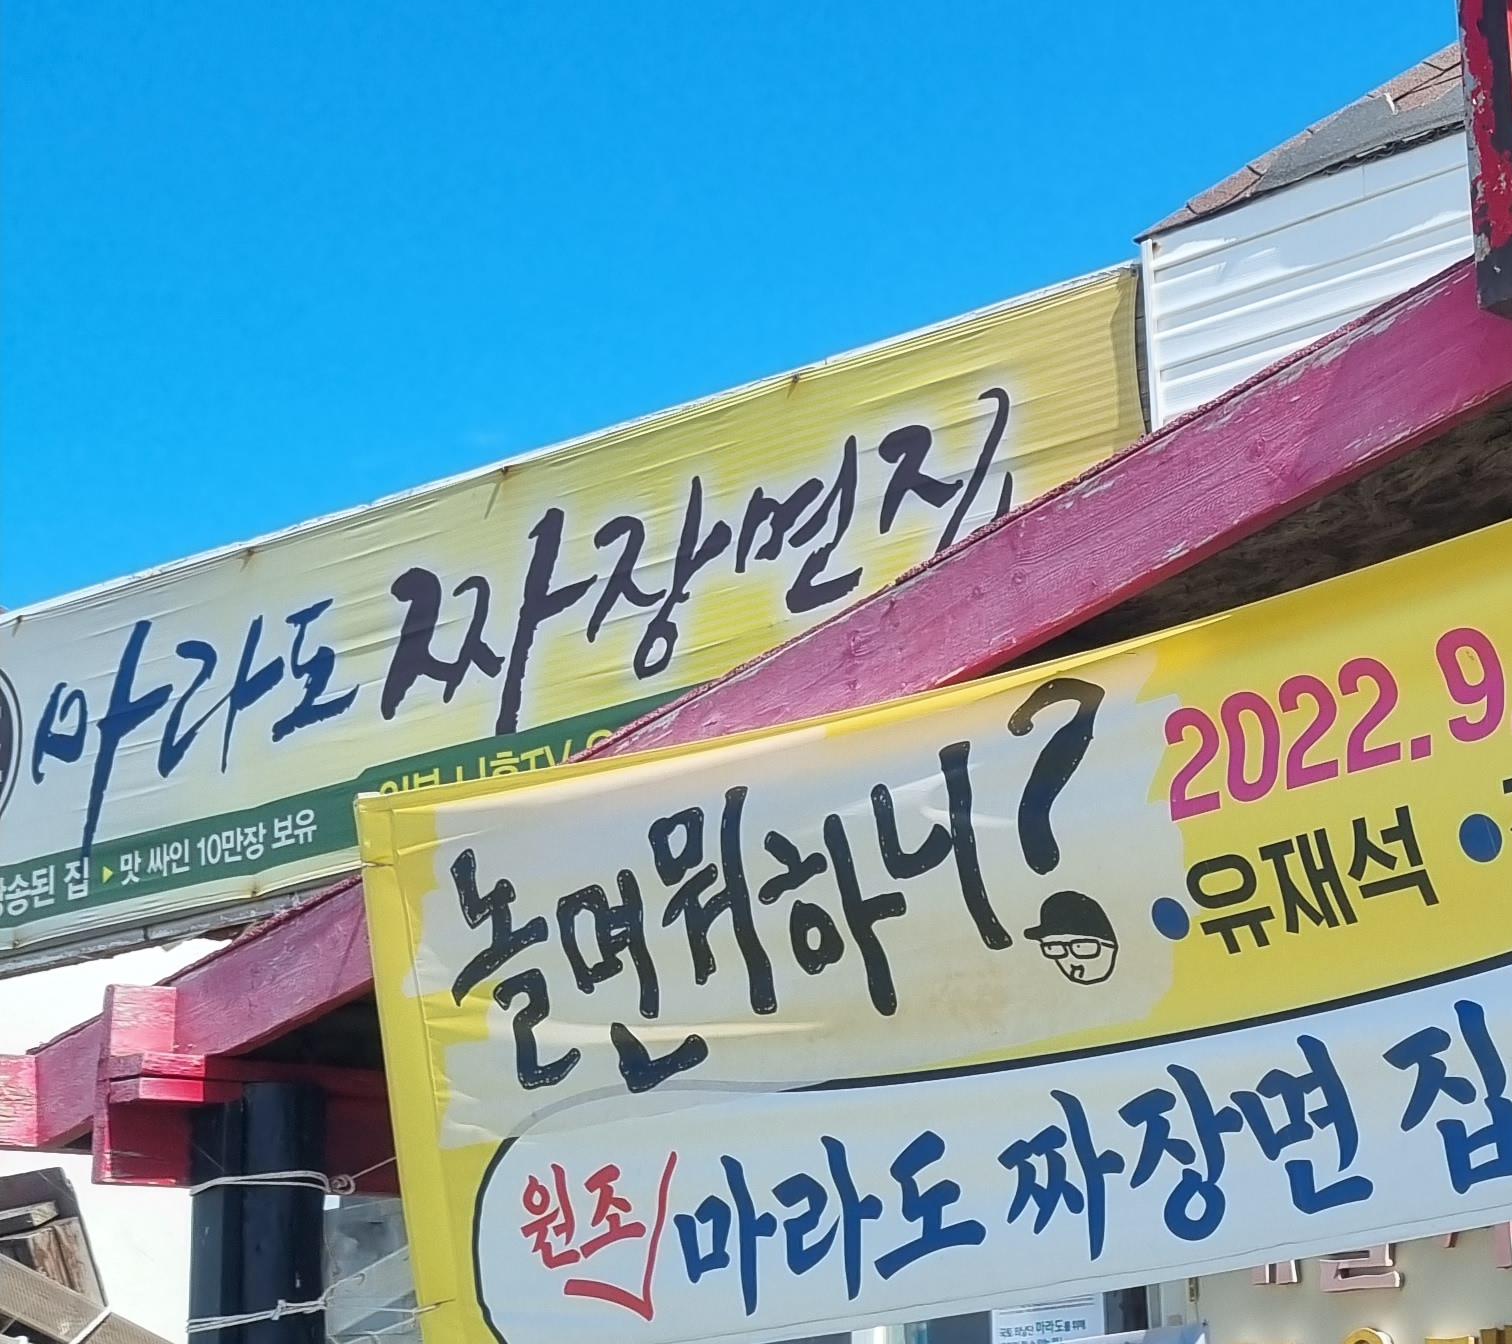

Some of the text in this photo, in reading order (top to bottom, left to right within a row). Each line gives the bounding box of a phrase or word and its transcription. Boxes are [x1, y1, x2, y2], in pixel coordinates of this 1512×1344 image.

[63, 857, 89, 900] 집
[119, 850, 141, 885] 맛
[149, 839, 190, 877] 싸인
[196, 821, 267, 866] 10만장
[271, 808, 318, 849] 보유
[452, 677, 1105, 1093] 놀면뭐하니?
[1185, 806, 1440, 955] 유재석
[520, 1164, 646, 1270] 원조
[672, 1129, 987, 1317] 마라도
[998, 1034, 1374, 1262] 짜장면
